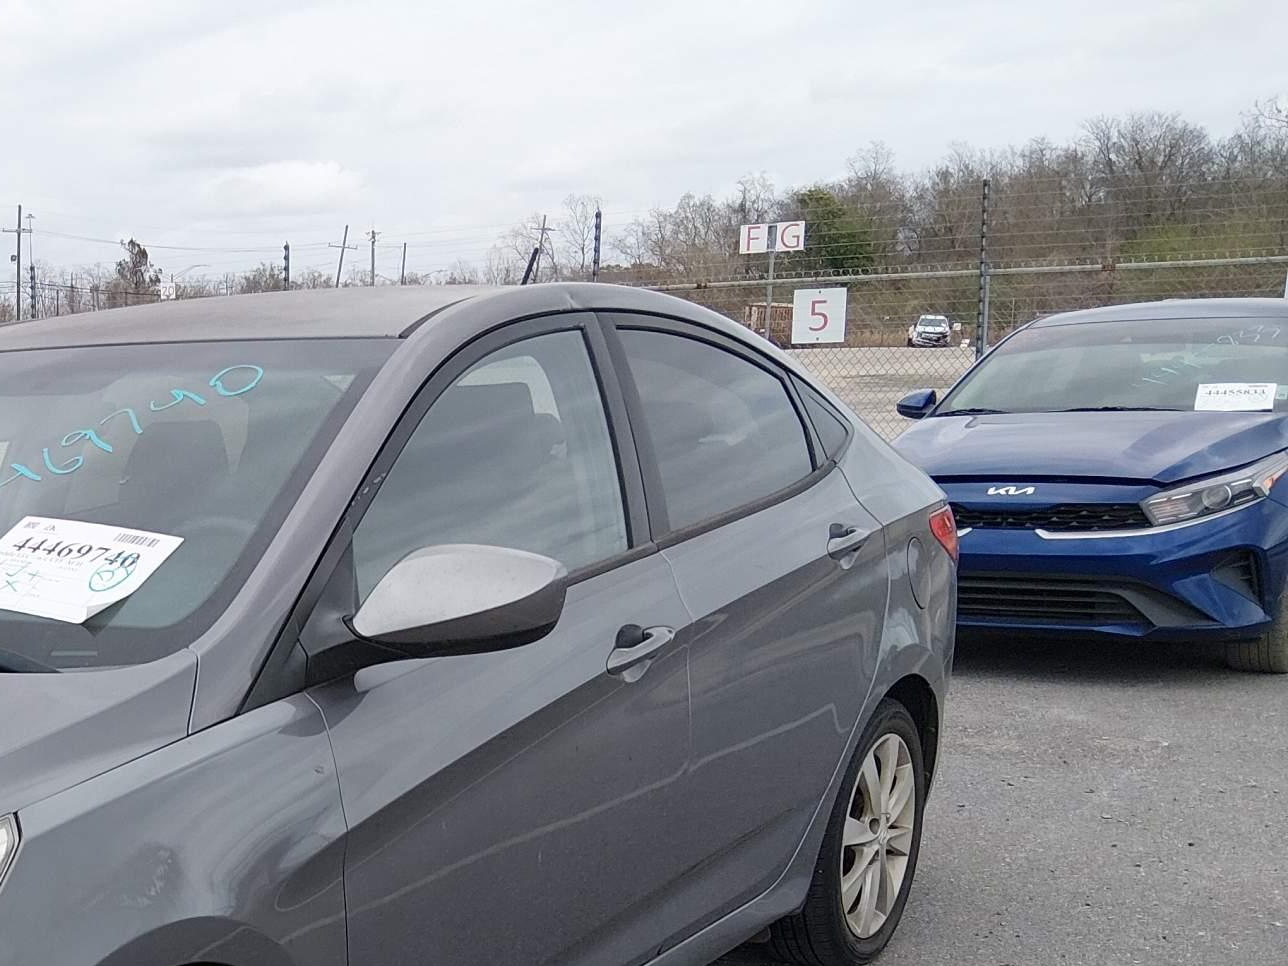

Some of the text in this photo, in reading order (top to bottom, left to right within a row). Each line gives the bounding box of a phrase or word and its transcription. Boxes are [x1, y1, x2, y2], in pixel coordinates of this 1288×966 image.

[746, 225, 761, 251] F
[780, 223, 801, 249] G
[808, 299, 829, 332] 5
[12, 536, 141, 569] 44469740
